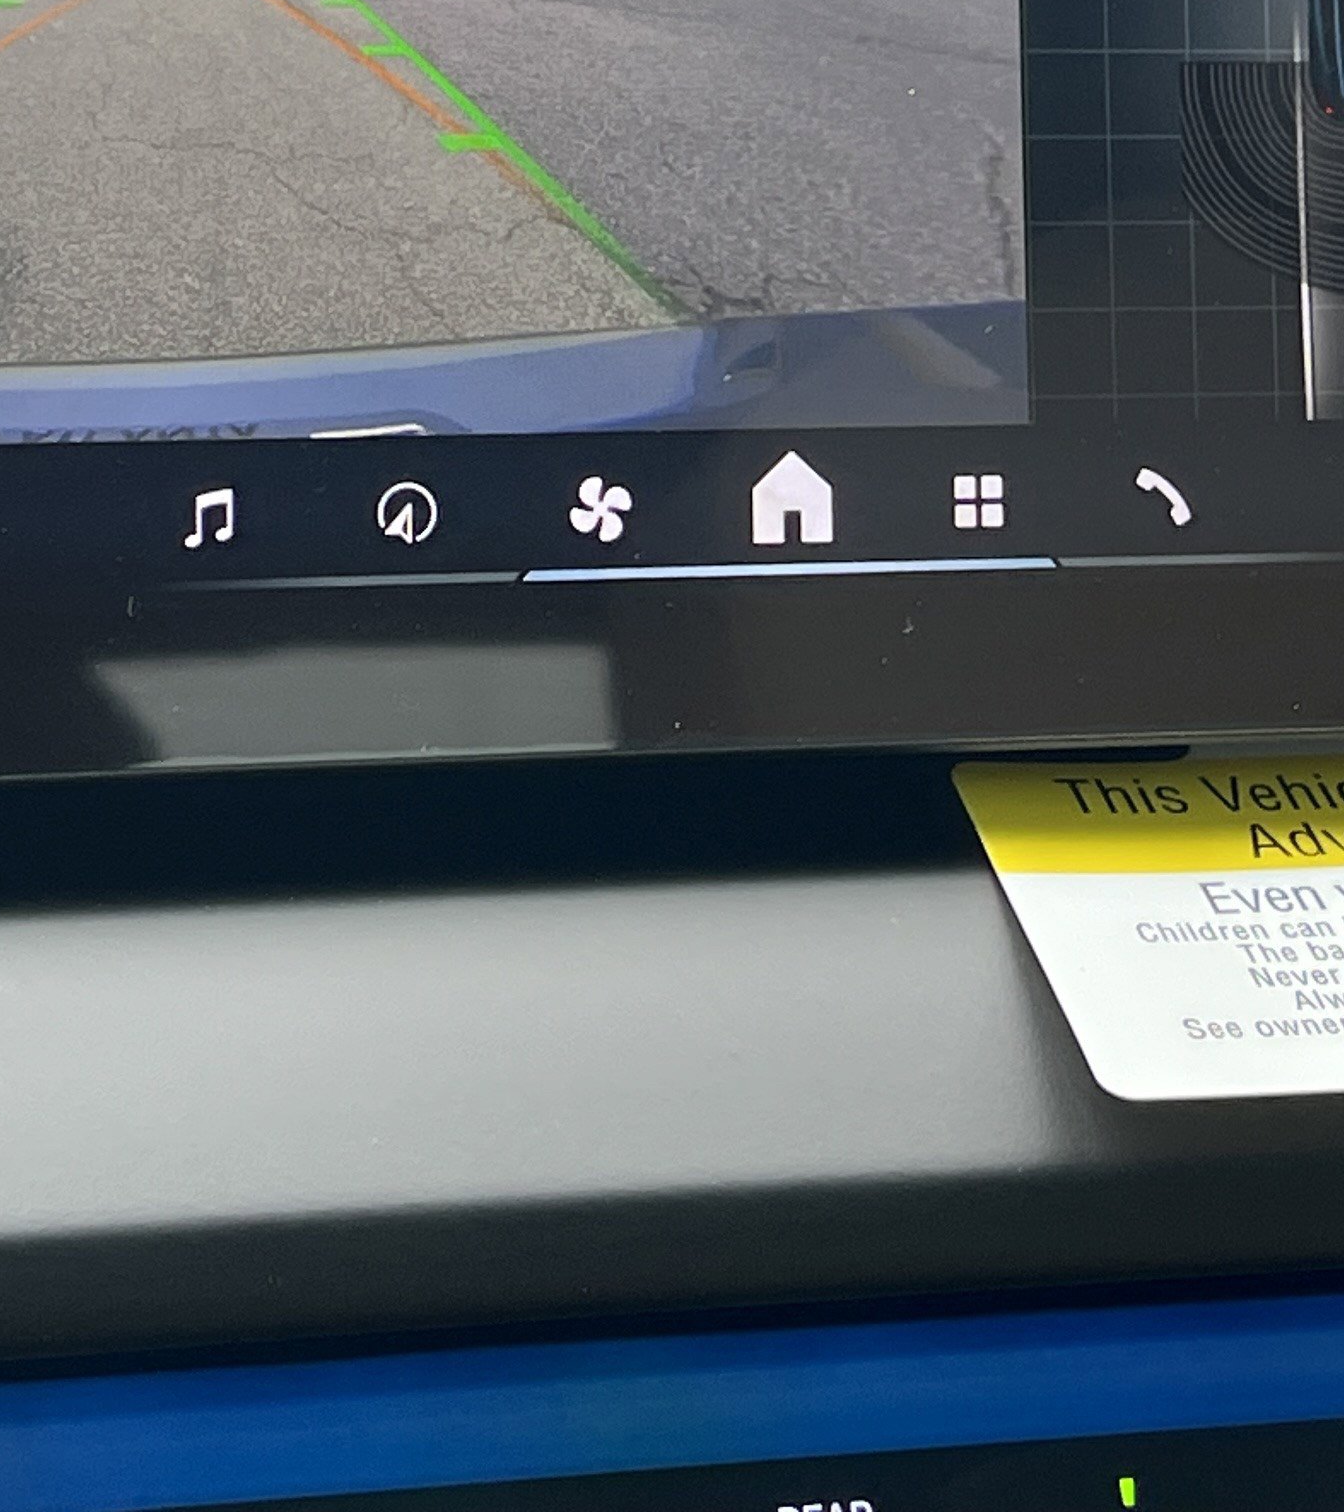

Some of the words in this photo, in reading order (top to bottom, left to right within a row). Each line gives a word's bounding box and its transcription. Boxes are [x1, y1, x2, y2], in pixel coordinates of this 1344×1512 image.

[1053, 777, 1189, 814] This
[1198, 881, 1327, 915] Even
[1135, 920, 1270, 943] Children
[1280, 917, 1337, 939] can
[1236, 942, 1298, 964] The
[1247, 964, 1340, 988] Never
[1182, 1018, 1244, 1039] See
